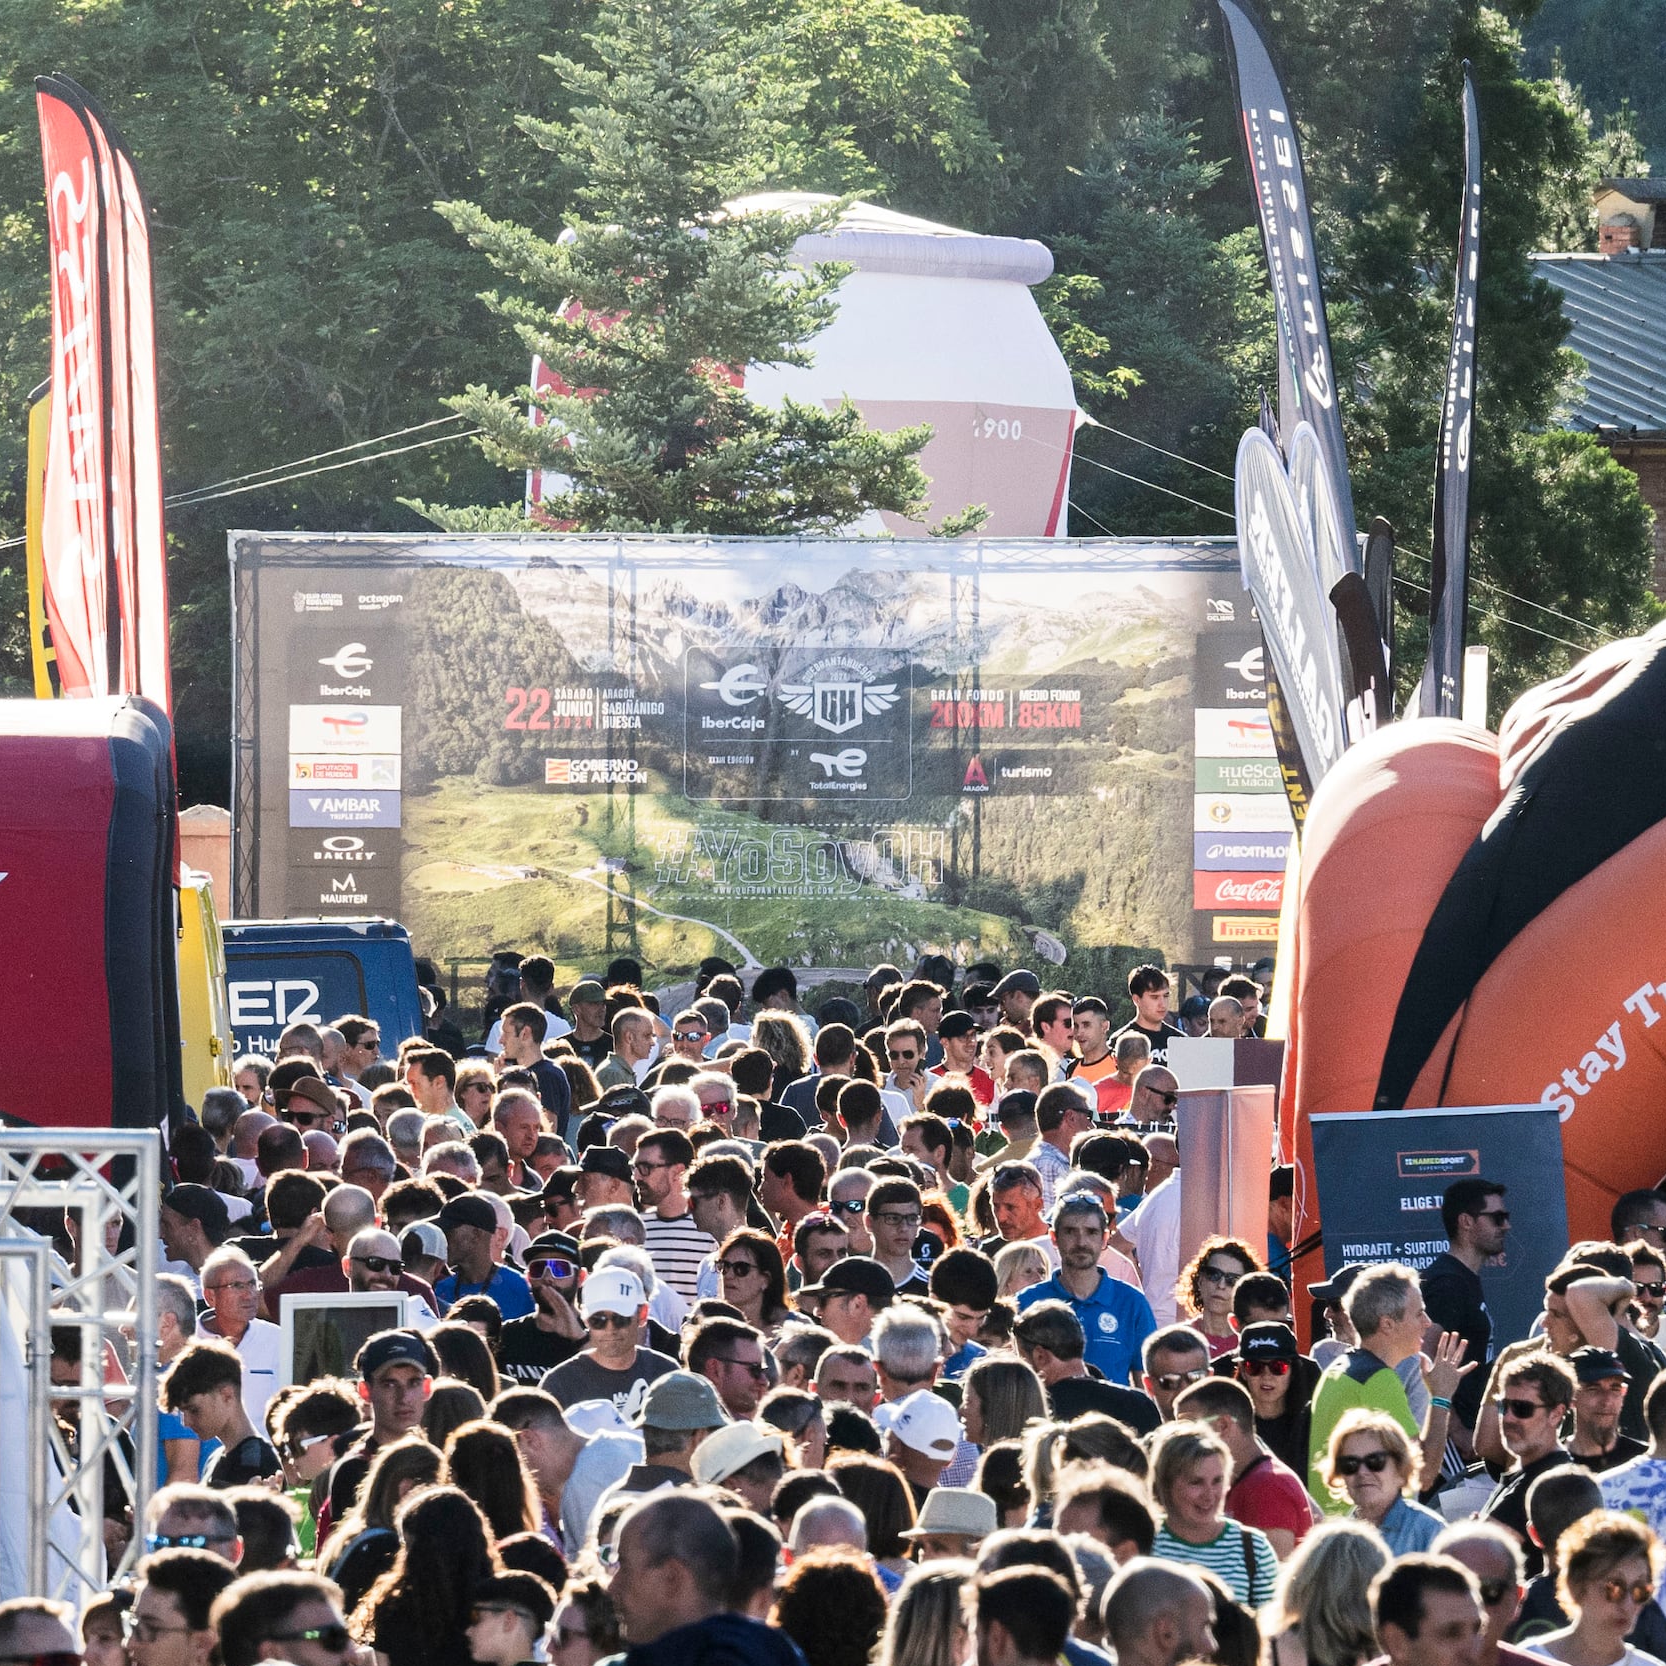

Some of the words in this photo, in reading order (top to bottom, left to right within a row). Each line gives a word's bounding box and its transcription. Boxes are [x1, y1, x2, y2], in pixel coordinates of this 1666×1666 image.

[358, 594, 404, 608] octagon
[930, 689, 959, 701] GRAN
[966, 689, 1005, 701] FONDO
[1019, 690, 1048, 701] MEDIO
[1050, 690, 1081, 701] FONDO
[504, 687, 551, 730] 22
[554, 686, 593, 700] SÁBADO
[552, 701, 594, 717] JUNIO
[601, 699, 665, 715] SABIÑÁNIGO
[930, 702, 1005, 728] 200KM
[1018, 702, 1082, 728] 85KM
[553, 718, 593, 729] 2024
[602, 716, 642, 729] HUESCA
[701, 715, 765, 732] iberCaja
[571, 759, 639, 772] GOBIERNO
[1000, 765, 1053, 778] turismo
[570, 772, 588, 783] DE
[809, 781, 868, 792] TotalEnergies
[321, 797, 382, 813] AMBAR
[313, 851, 377, 861] OAKLEY
[654, 829, 945, 894] #YoSoyQH
[320, 893, 368, 904] MAURTEN
[1540, 1019, 1628, 1124] Stay
[1413, 1155, 1466, 1166] NAMEDSPORT
[1400, 1197, 1432, 1211] ELIGE
[1341, 1242, 1393, 1257] HYDRAFIT
[1404, 1240, 1451, 1256] SURTIDO
